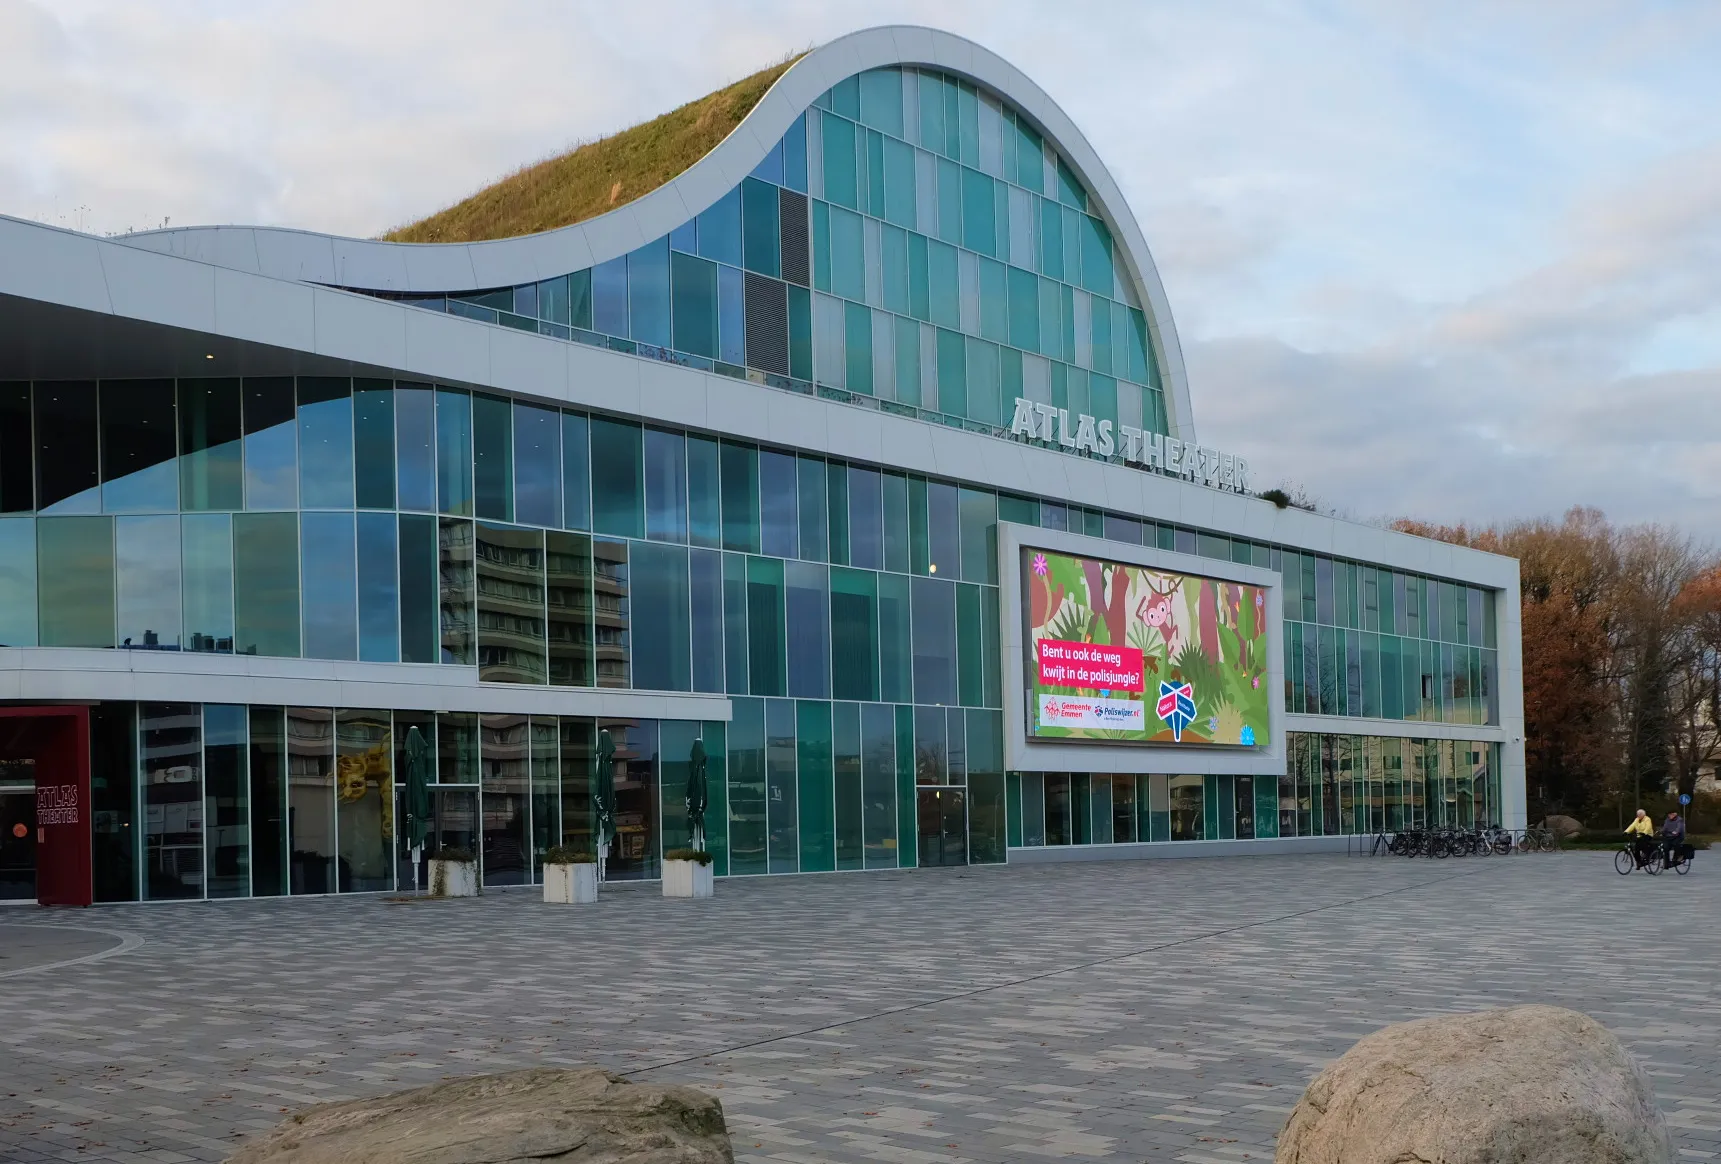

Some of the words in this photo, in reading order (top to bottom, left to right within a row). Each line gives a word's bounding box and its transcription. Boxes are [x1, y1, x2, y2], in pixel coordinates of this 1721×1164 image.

[1011, 397, 1115, 456] ATLAS
[1121, 425, 1250, 489] THEATER
[1042, 643, 1063, 659] Bent
[1065, 649, 1071, 659] u
[1072, 648, 1090, 661] ook
[1090, 649, 1102, 662] de
[1103, 653, 1121, 667] weg
[1043, 664, 1066, 681] kwijt
[1067, 666, 1076, 679] in
[1077, 667, 1089, 680] de
[1090, 669, 1140, 686] polisjungle?
[1061, 702, 1092, 712] Gemeente
[1061, 710, 1082, 718] Emmen
[37, 785, 78, 808] ATLAS
[37, 807, 79, 825] THEATER
